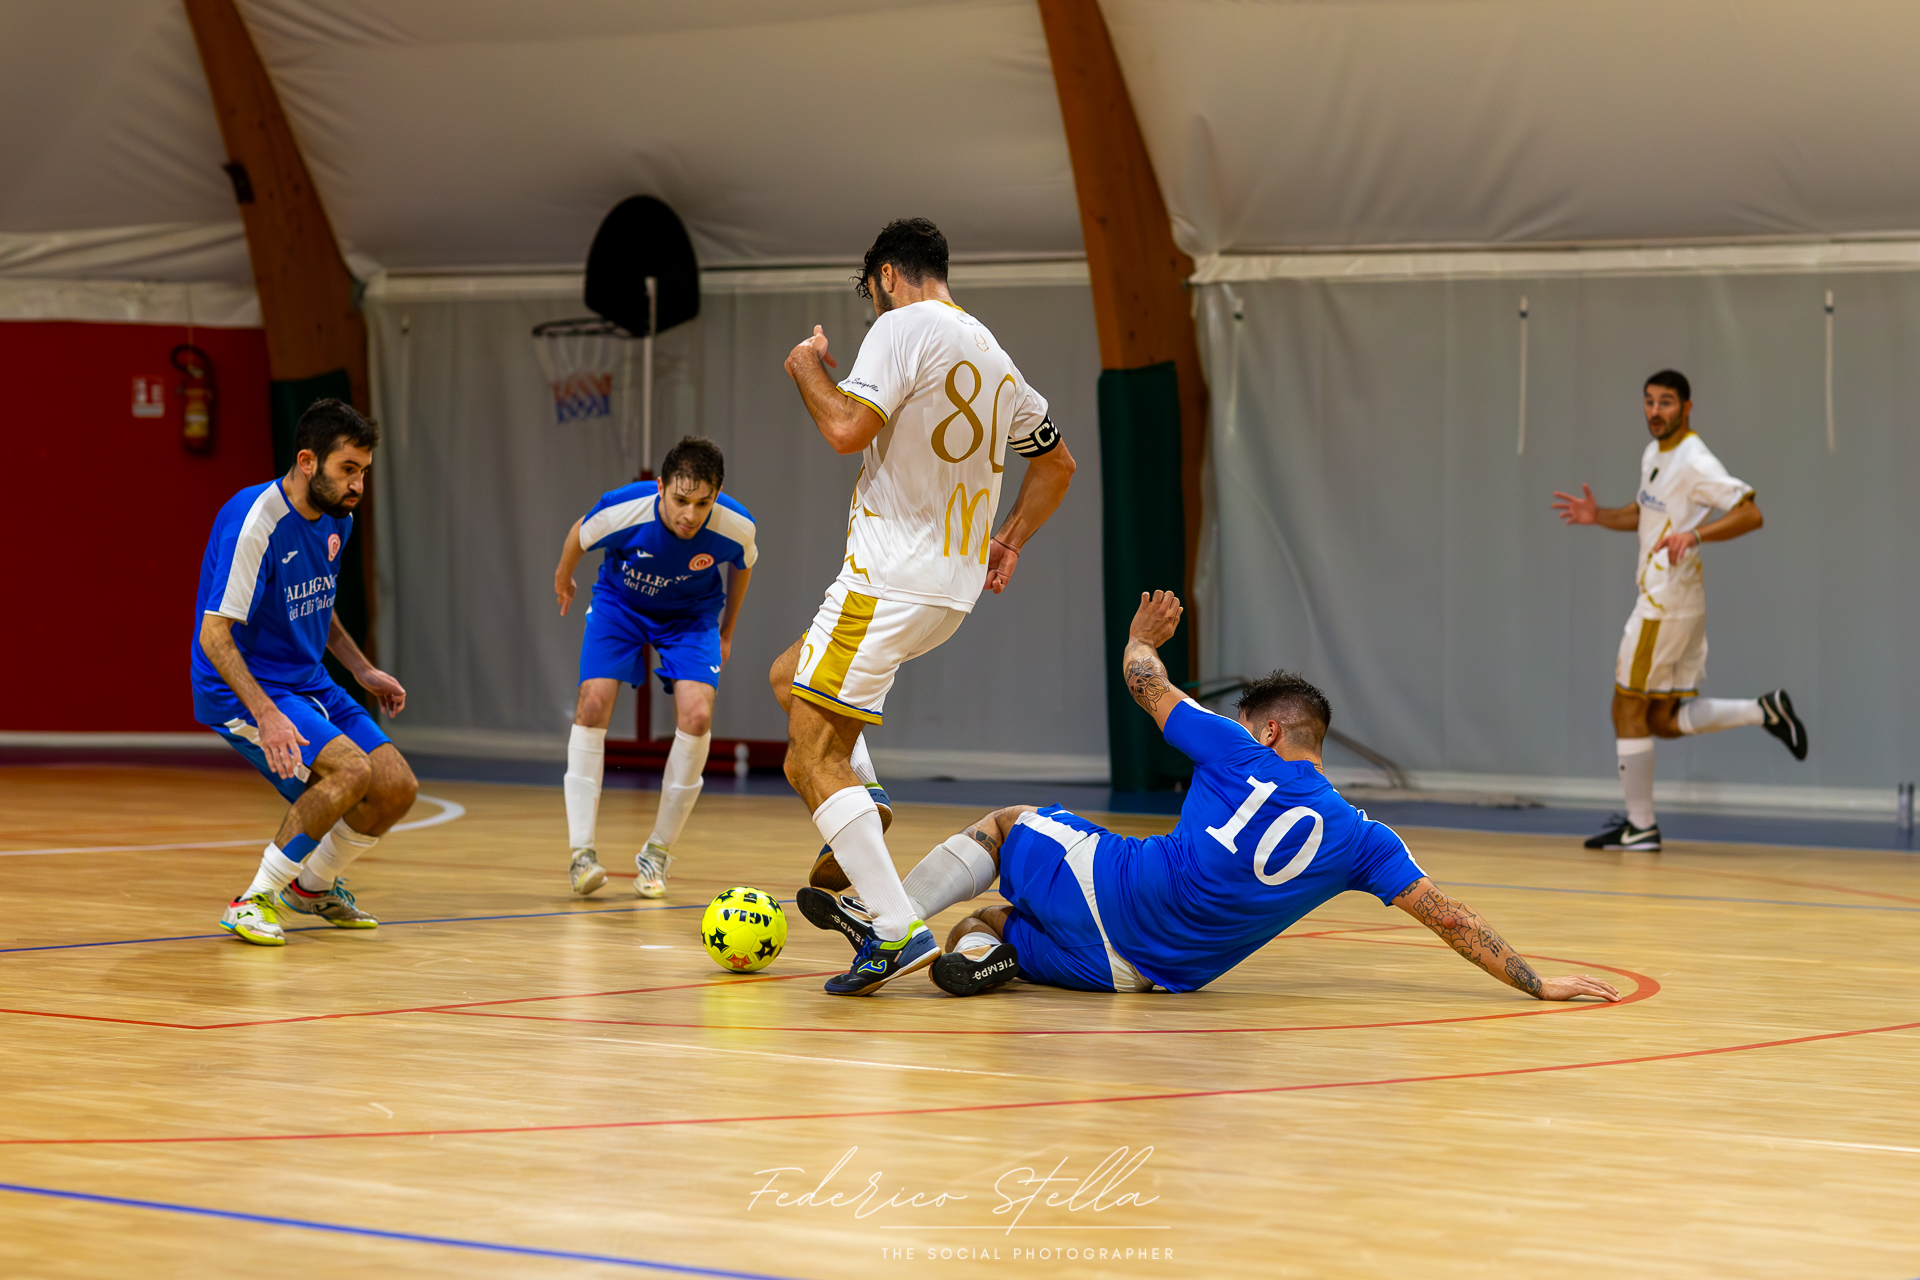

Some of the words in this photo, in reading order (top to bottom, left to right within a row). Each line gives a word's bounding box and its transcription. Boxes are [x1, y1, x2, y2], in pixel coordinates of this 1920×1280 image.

[1034, 422, 1055, 447] C
[1204, 775, 1324, 886] 10
[723, 908, 773, 928] AGLA
[971, 957, 1016, 981] TIEMPO
